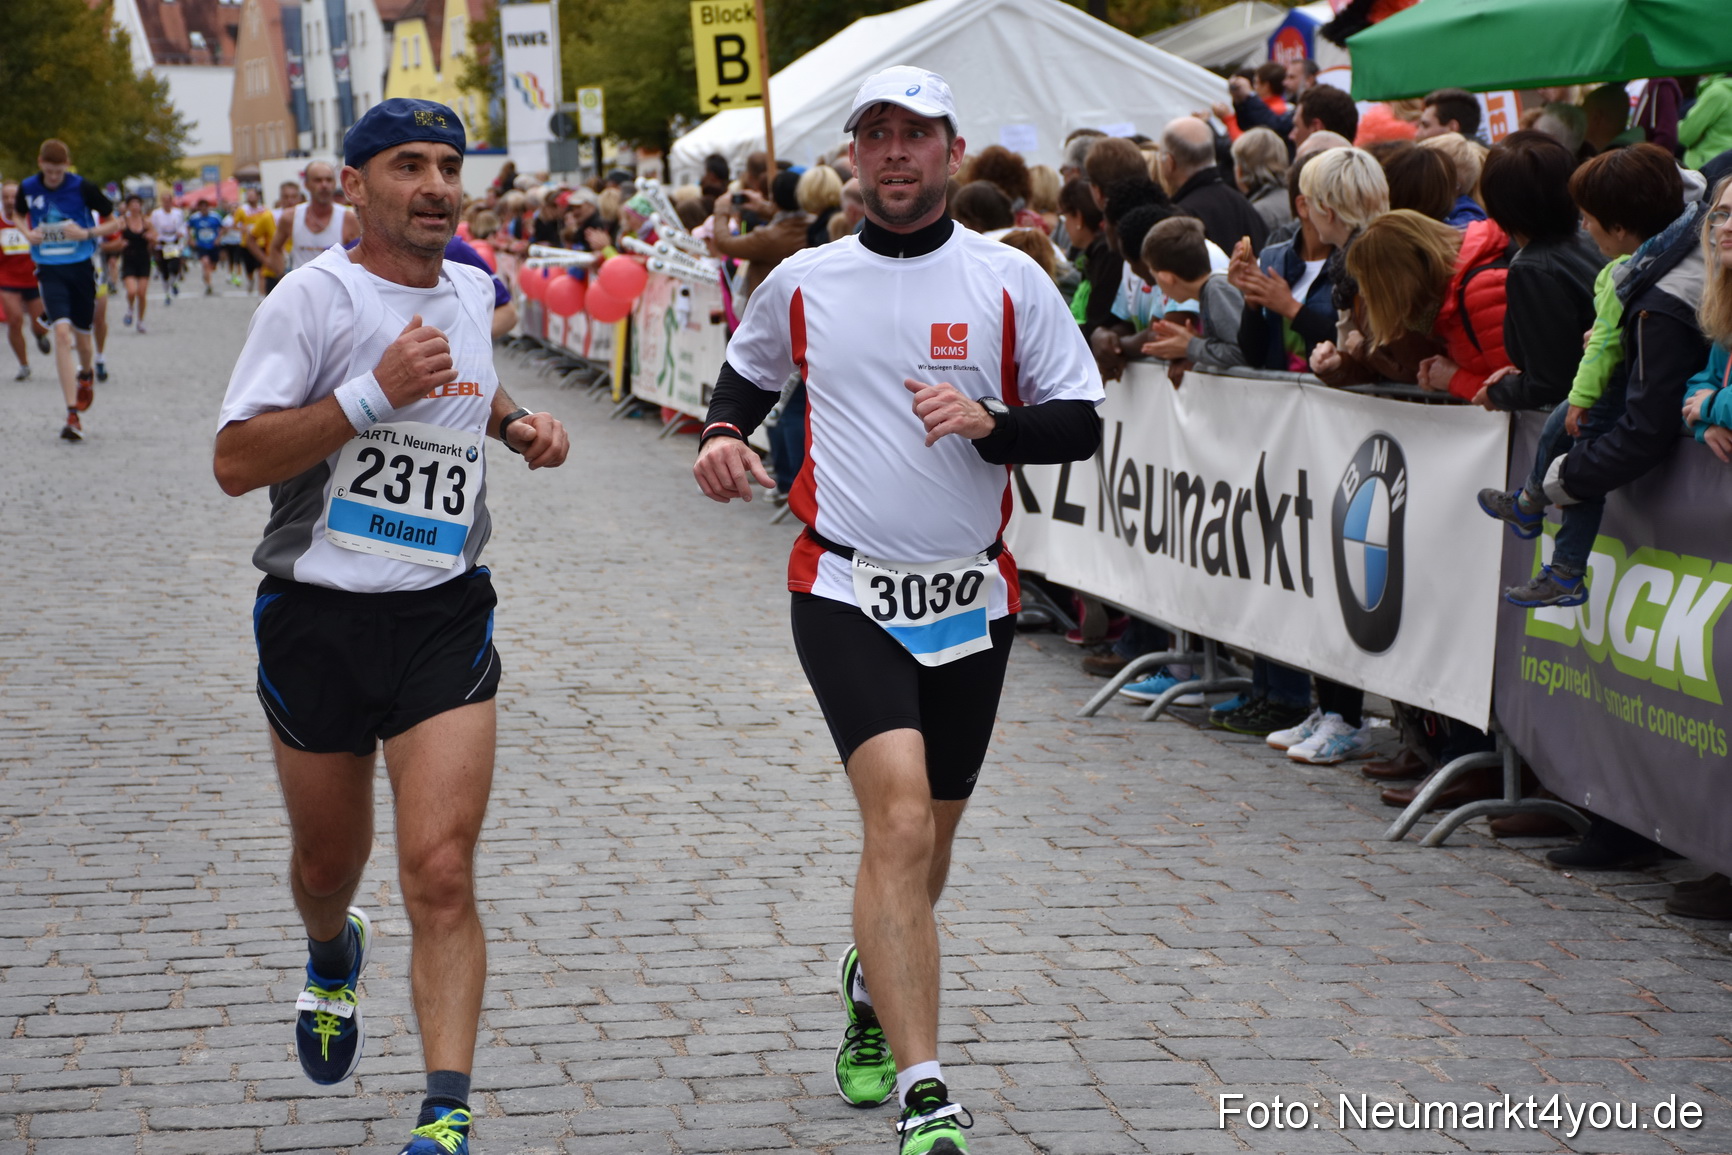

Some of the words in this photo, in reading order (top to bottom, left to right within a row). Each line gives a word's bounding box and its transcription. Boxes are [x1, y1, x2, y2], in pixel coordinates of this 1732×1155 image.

[701, 4, 757, 25] Block
[714, 33, 750, 86] B
[933, 346, 965, 356] DKMS
[422, 382, 483, 398] LEBL
[352, 429, 400, 445] ARTL
[403, 434, 463, 458] Neumarkt
[337, 487, 345, 498] C
[349, 447, 467, 516] 2313
[1341, 438, 1406, 514] BMW
[1095, 417, 1314, 598] Neumarkt
[369, 513, 438, 546] Roland
[870, 569, 985, 622] 3030
[1521, 646, 1592, 700] inspired
[1604, 687, 1644, 728] smart
[1647, 705, 1729, 758] concepts
